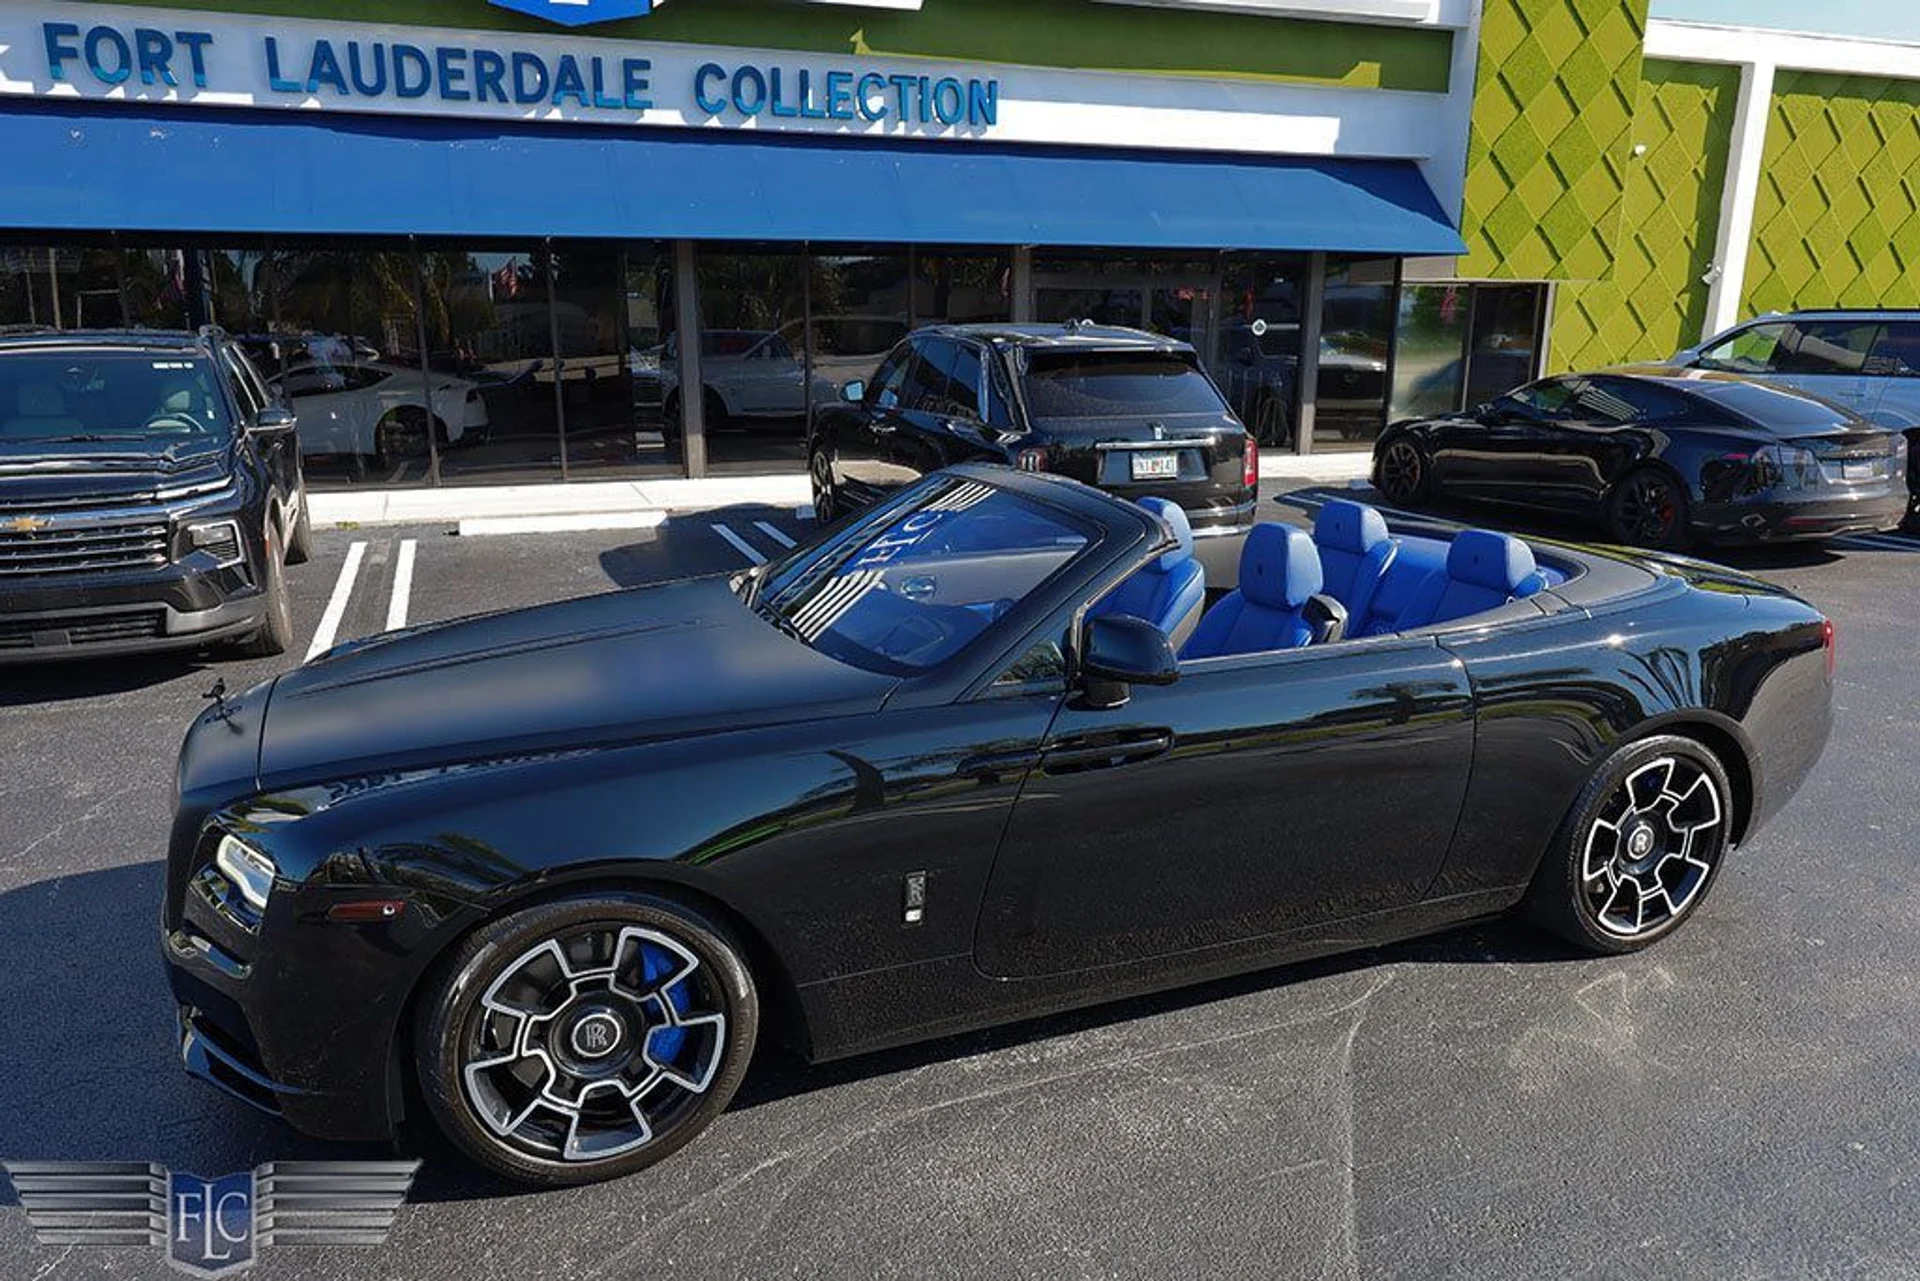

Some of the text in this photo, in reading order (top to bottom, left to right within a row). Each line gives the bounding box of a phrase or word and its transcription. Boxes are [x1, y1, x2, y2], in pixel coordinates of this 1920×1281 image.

[43, 22, 997, 125] FORT LAUDERDALE COLLECTION
